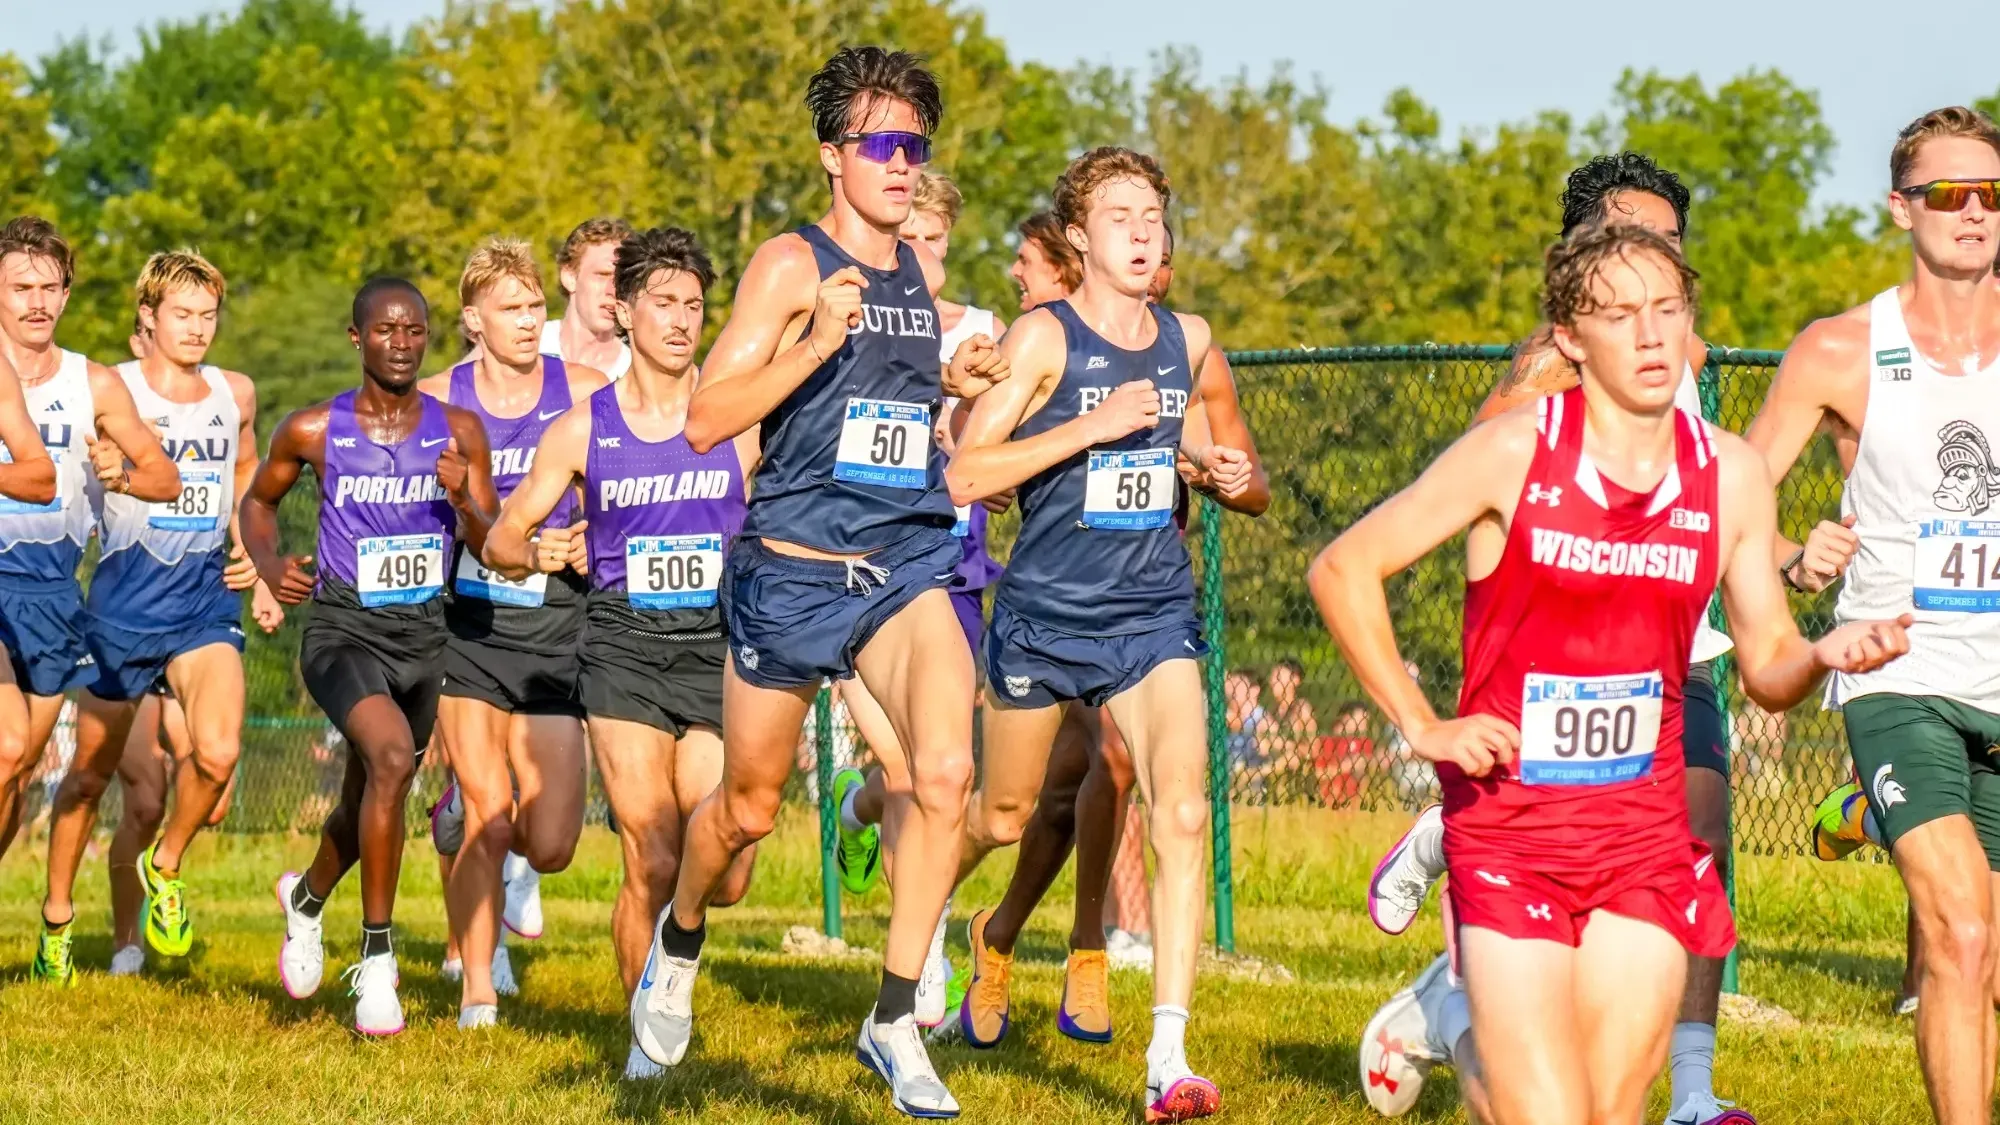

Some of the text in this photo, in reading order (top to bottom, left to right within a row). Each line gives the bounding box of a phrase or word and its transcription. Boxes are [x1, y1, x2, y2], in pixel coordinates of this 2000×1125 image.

[1078, 387, 1188, 418] BER
[871, 423, 907, 466] 50
[601, 470, 730, 511] PORTLAND
[845, 469, 886, 480] SEPTEMBER
[1116, 471, 1151, 510] 58
[1094, 517, 1133, 525] SEPTEMBER
[377, 554, 427, 588] 496
[648, 554, 704, 591] 506
[1531, 528, 1698, 584] WISCONSIN
[1928, 596, 1977, 606] SEPTEMBER
[1554, 705, 1636, 758] 960
